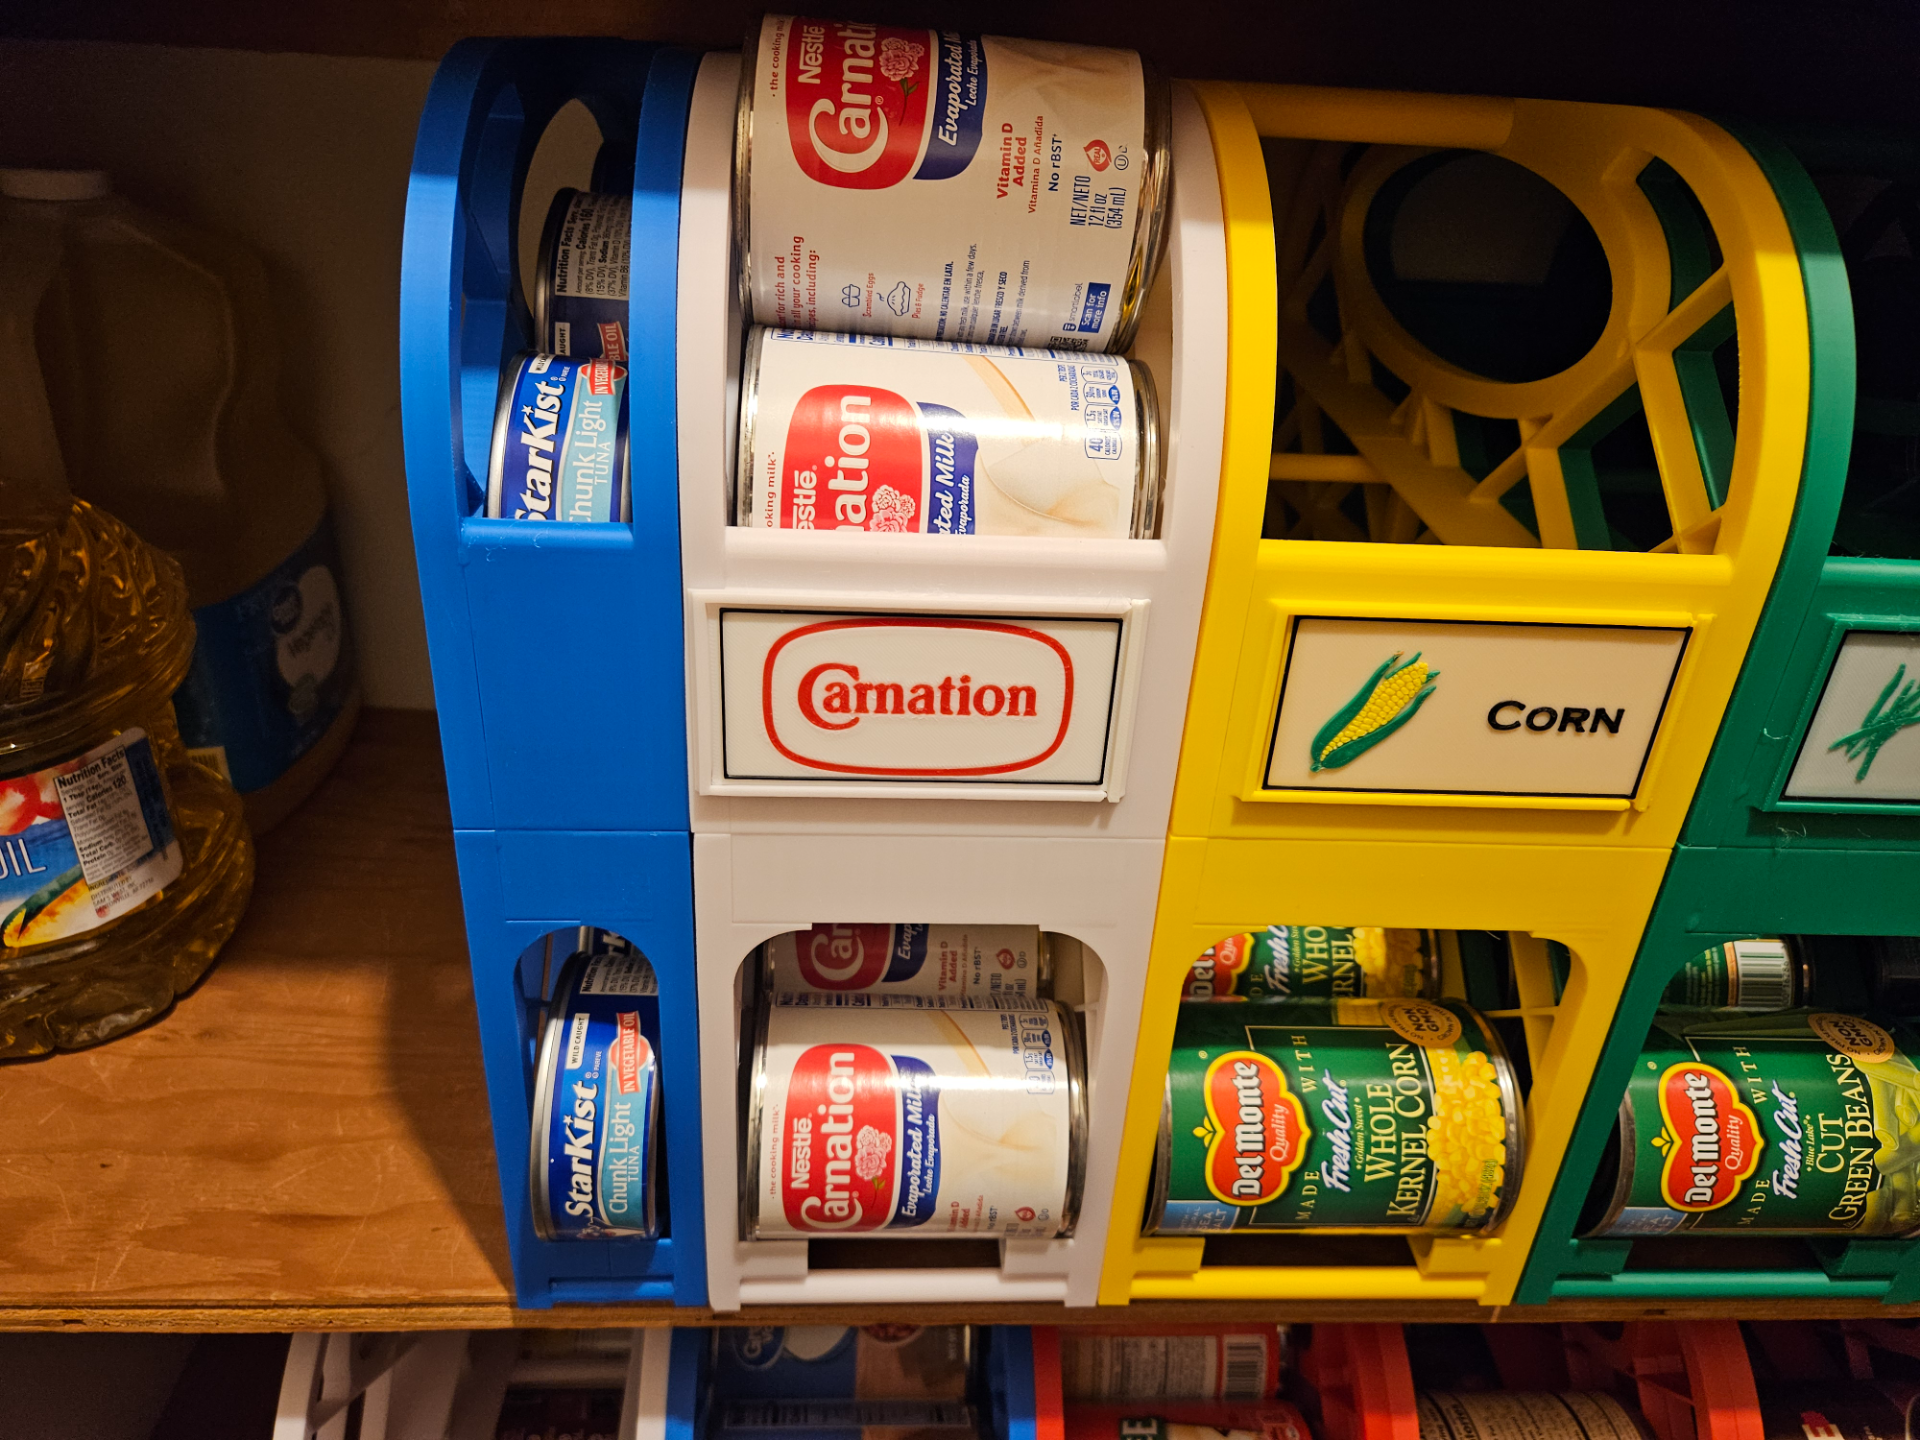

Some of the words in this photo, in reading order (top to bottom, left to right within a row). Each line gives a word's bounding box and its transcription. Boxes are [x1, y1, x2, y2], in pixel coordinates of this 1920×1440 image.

[772, 33, 784, 69] cooking
[769, 71, 779, 91] the
[938, 44, 968, 146] Evaporated
[965, 77, 978, 106] Leche
[1002, 122, 1013, 134] D
[1033, 115, 1044, 155] Añadida
[996, 136, 1012, 199] Vitamin
[1012, 136, 1027, 187] Added
[1032, 157, 1040, 165] D
[1028, 168, 1040, 213] Vitamina
[1048, 172, 1060, 192] No
[1108, 186, 1127, 206] mL)
[1069, 175, 1091, 226] NET/NETO
[1093, 192, 1108, 204] oz
[1088, 215, 1105, 227] 12
[1105, 207, 1124, 229] (354
[560, 226, 574, 247] Facts
[576, 223, 590, 250] Calories
[598, 240, 610, 263] Sodium
[791, 236, 804, 285] cooking
[966, 260, 975, 272] few
[967, 243, 977, 260] days.
[557, 249, 570, 293] Nutrition
[775, 256, 785, 279] and
[806, 250, 820, 306] including:
[865, 272, 874, 288] Eggs
[943, 278, 951, 286] EN
[944, 261, 954, 277] LATA.
[998, 271, 1007, 286] SECO
[1020, 260, 1030, 275] from
[597, 279, 606, 295] (15%
[609, 280, 618, 296] (37%
[618, 274, 628, 297] Vitamin
[775, 281, 785, 301] rich
[793, 288, 803, 308] your
[940, 287, 951, 310] CALENTAR
[963, 278, 972, 295] within
[1017, 276, 1028, 297] derived
[1086, 293, 1096, 306] for
[1095, 291, 1107, 308] info
[775, 302, 785, 313] for
[1081, 308, 1093, 326] Scan
[1092, 310, 1102, 329] more
[605, 323, 617, 341] OIL
[595, 386, 608, 394] IN
[1070, 400, 1080, 411] POR
[574, 400, 606, 448] Light
[594, 442, 611, 485] TUNA
[934, 432, 955, 487] Milk
[792, 470, 817, 529] estlé
[798, 662, 1037, 730] Carnation
[1487, 699, 1625, 735] CORN
[57, 764, 101, 789] Nutrition
[102, 749, 125, 769] Facts
[86, 783, 113, 802] Calories
[113, 774, 127, 790] 120
[68, 806, 86, 819] Total
[940, 941, 948, 949] D
[1291, 940, 1301, 967] Golden
[1302, 927, 1328, 983] WHO
[938, 951, 948, 990] Vitamin
[948, 950, 957, 982] Added
[973, 972, 981, 985] No
[574, 1016, 585, 1044] CAUGHT
[622, 1012, 635, 1028] OIL
[1402, 1008, 1426, 1031] NON
[1415, 1008, 1439, 1032] GMO
[1829, 1021, 1861, 1046] NON
[1842, 1021, 1873, 1046] GMO
[571, 1045, 581, 1064] WILD
[623, 1028, 635, 1079] VEGETABLE
[1291, 1034, 1318, 1093] WITH
[623, 1079, 636, 1092] IN
[1385, 1041, 1426, 1118] CORN
[1733, 1045, 1768, 1104] WITH
[1231, 1060, 1266, 1152] Monte
[1321, 1069, 1352, 1129] Cut
[1772, 1079, 1803, 1140] Cut
[1825, 1053, 1874, 1139] BEANS
[609, 1101, 635, 1153] Light
[1354, 1104, 1364, 1131] Sweet
[1684, 1072, 1720, 1161] Monte
[800, 1051, 864, 1229] Carnation
[925, 1114, 939, 1168] Evaporada
[1268, 1103, 1290, 1162] Quality
[1364, 1083, 1398, 1182] WHOLE
[1724, 1114, 1744, 1170] Quality
[1815, 1112, 1846, 1173] CUT
[563, 1080, 598, 1218] StarKist
[770, 1137, 780, 1178] cooking
[790, 1117, 812, 1189] Nestlé
[1321, 1129, 1352, 1193] Fresh
[1354, 1132, 1364, 1164] Golden
[1805, 1146, 1816, 1166] Blue
[628, 1145, 640, 1182] TUNA
[901, 1127, 927, 1217] Evaporated
[1232, 1155, 1265, 1198] Del
[1385, 1124, 1428, 1217] KERNEL
[1771, 1140, 1803, 1200] Fresh
[608, 1157, 628, 1214] Chunk
[923, 1167, 934, 1194] Leche
[1684, 1164, 1719, 1204] Del
[1827, 1146, 1874, 1221] GREEN
[1294, 1170, 1321, 1221] MADE
[1736, 1179, 1771, 1225] MADE
